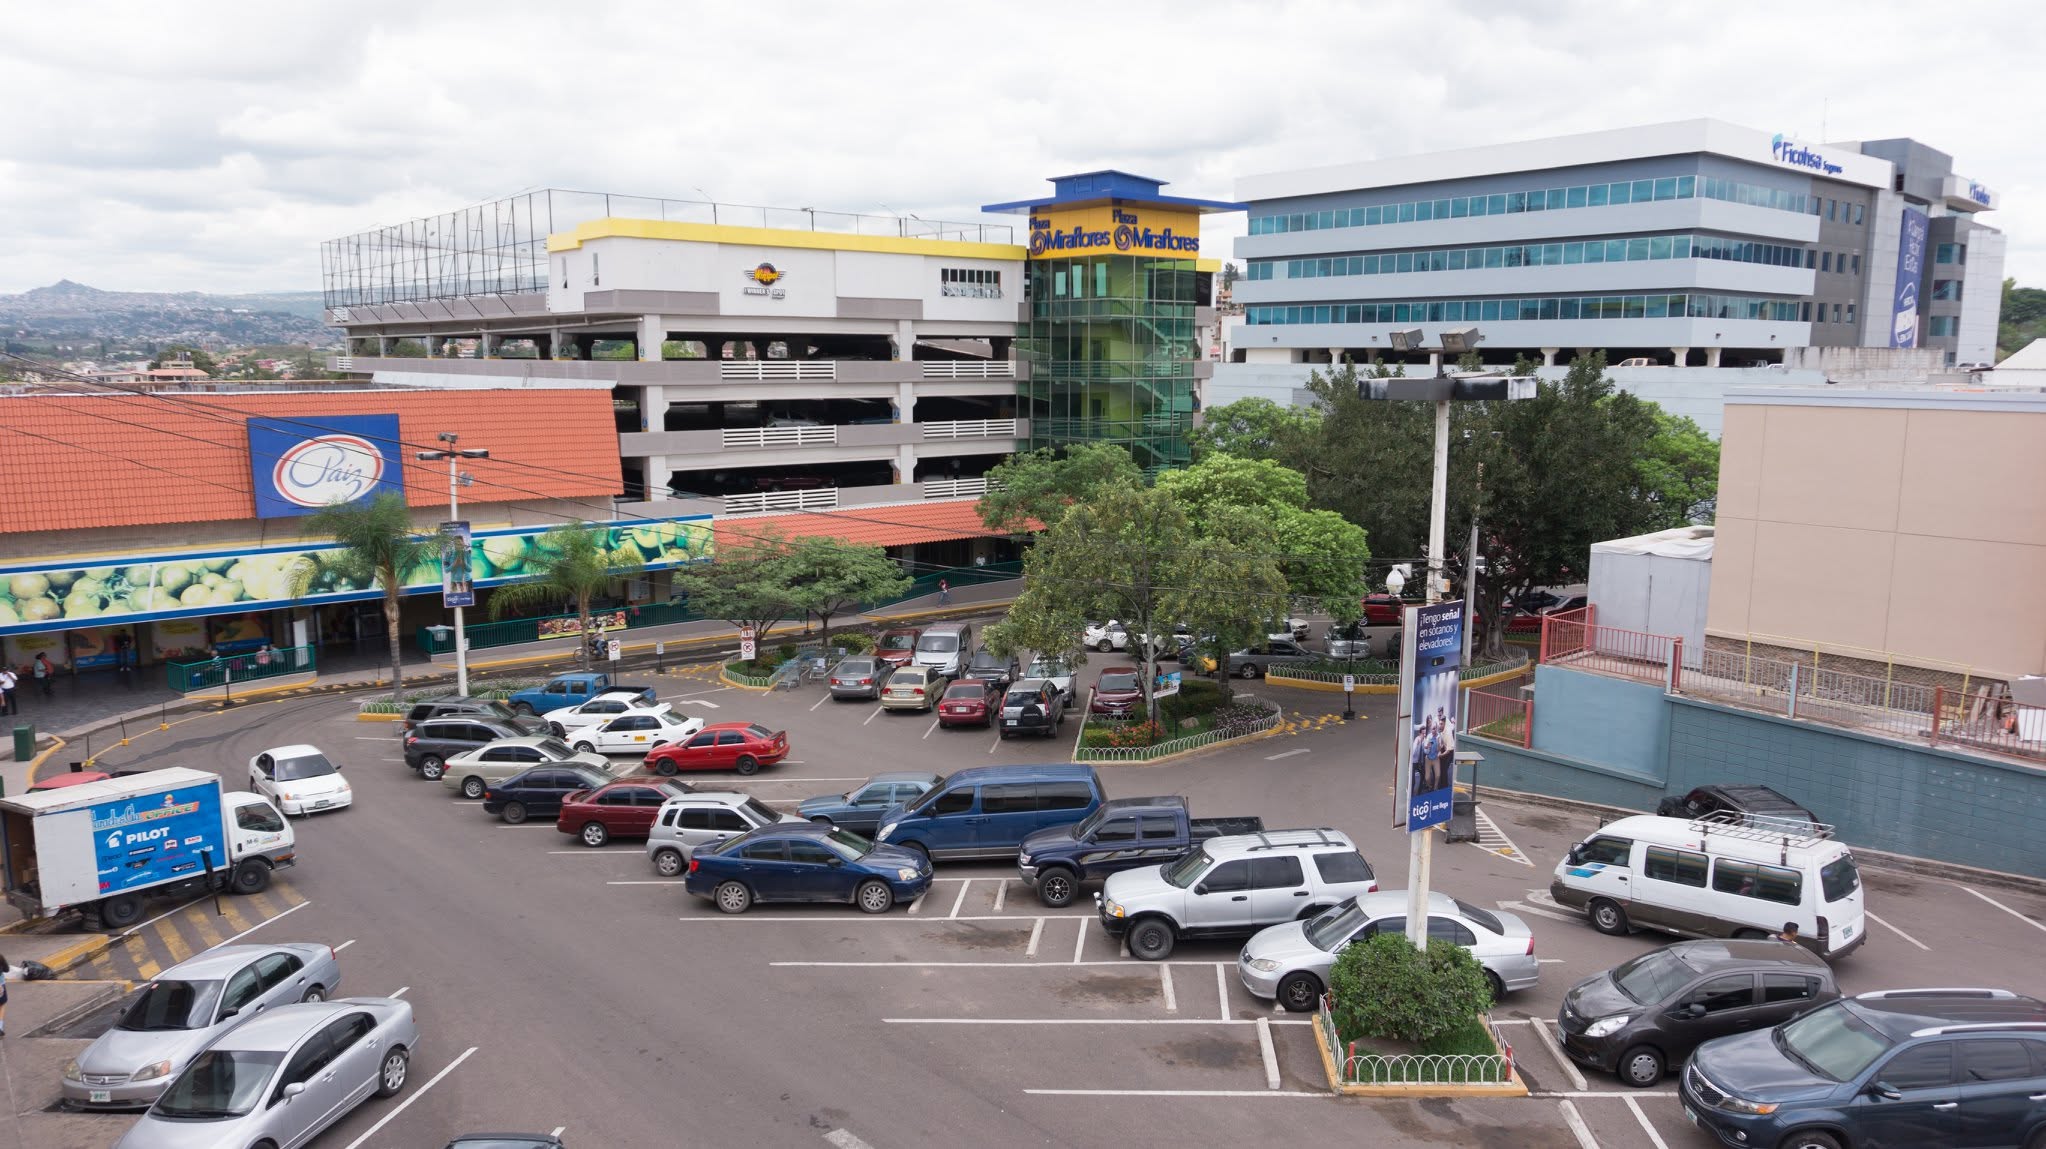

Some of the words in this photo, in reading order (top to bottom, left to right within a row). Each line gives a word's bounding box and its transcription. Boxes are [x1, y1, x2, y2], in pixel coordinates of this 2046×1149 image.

[1782, 142, 1822, 169] Ficohsa
[1029, 217, 1050, 230] Plaza
[1112, 208, 1138, 225] Plaza
[1045, 226, 1111, 250] Miraflores
[1133, 227, 1199, 251] Miraflores
[289, 446, 362, 497] Paiz
[1420, 613, 1441, 627] ¡Tengo
[1442, 608, 1460, 620] señal
[1420, 629, 1428, 637] en
[1419, 636, 1454, 650] elevadores!
[1412, 802, 1429, 820] tigo
[126, 827, 171, 844] PILOT
